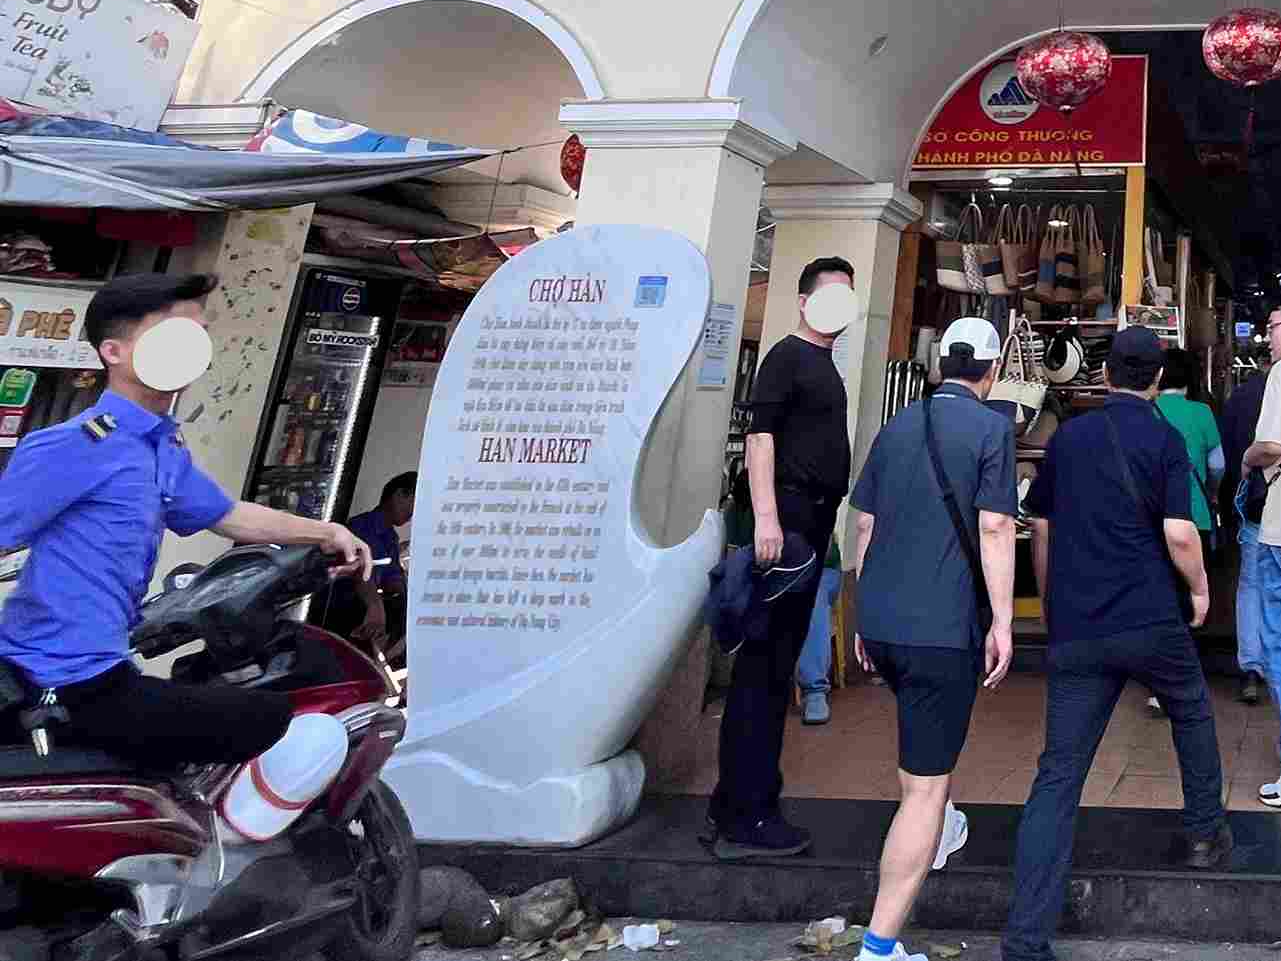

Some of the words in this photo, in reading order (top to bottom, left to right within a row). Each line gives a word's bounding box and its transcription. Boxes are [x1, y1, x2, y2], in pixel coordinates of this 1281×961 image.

[13, 11, 69, 42] Fruit
[12, 35, 49, 60] Tea
[479, 437, 517, 463] HAN
[517, 437, 592, 464] MARKET
